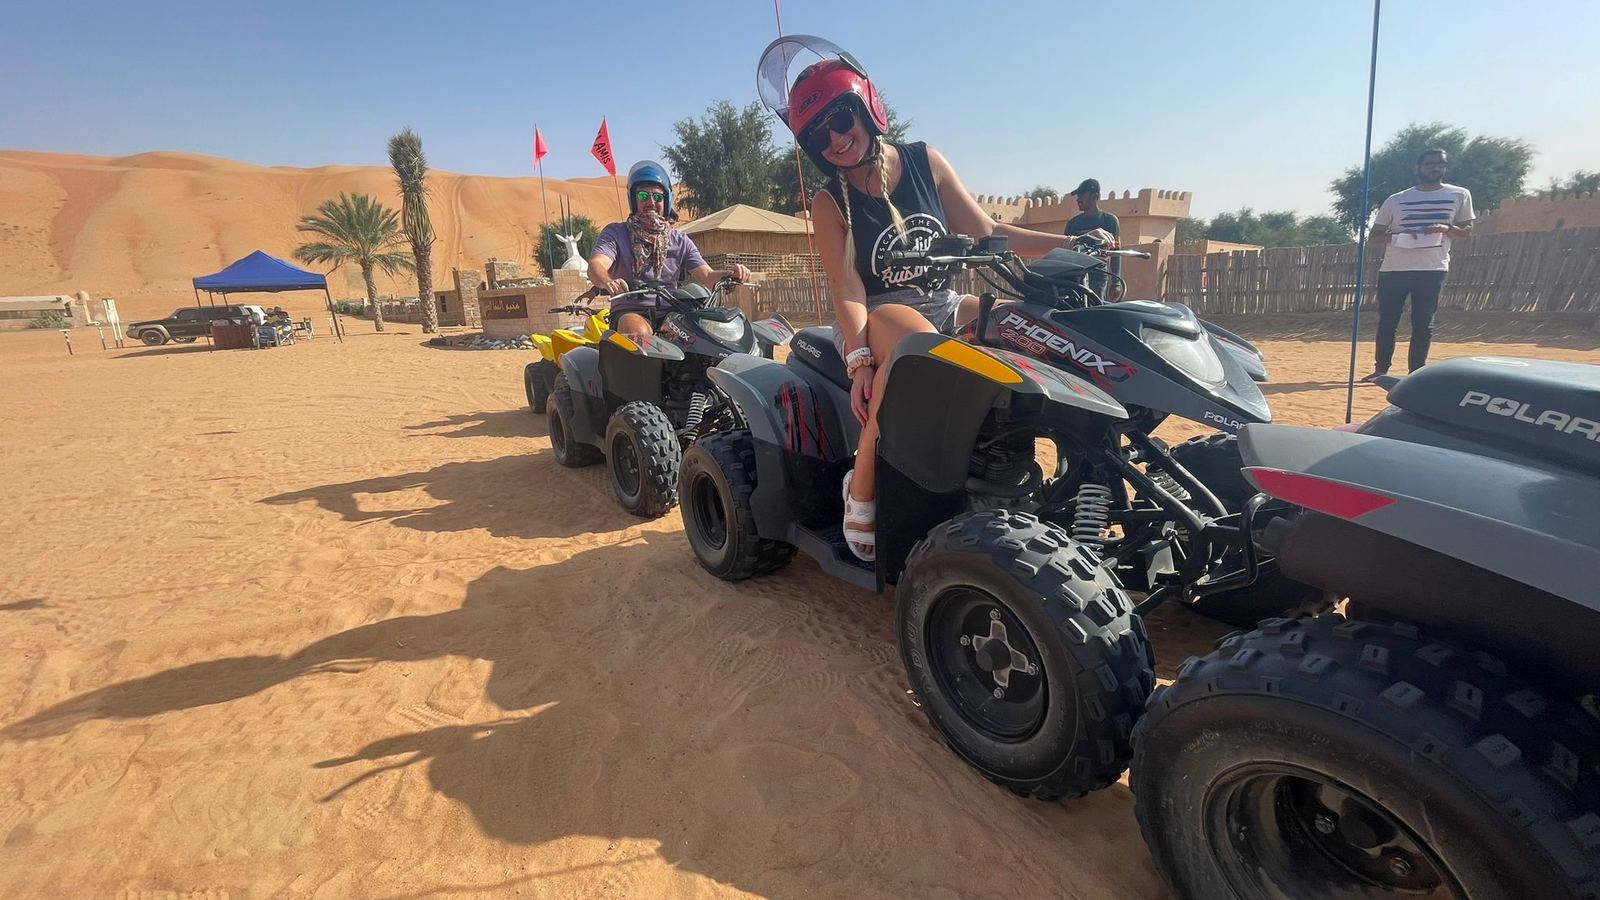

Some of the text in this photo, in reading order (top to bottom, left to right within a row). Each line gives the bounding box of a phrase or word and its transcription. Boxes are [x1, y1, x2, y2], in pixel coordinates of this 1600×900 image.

[911, 219, 931, 227] THE
[796, 338, 822, 359] POLARIS
[1000, 329, 1046, 354] 200
[1000, 312, 1116, 375] PHOENIX
[1203, 410, 1247, 430] POLAR
[1459, 390, 1600, 443] POLAR
